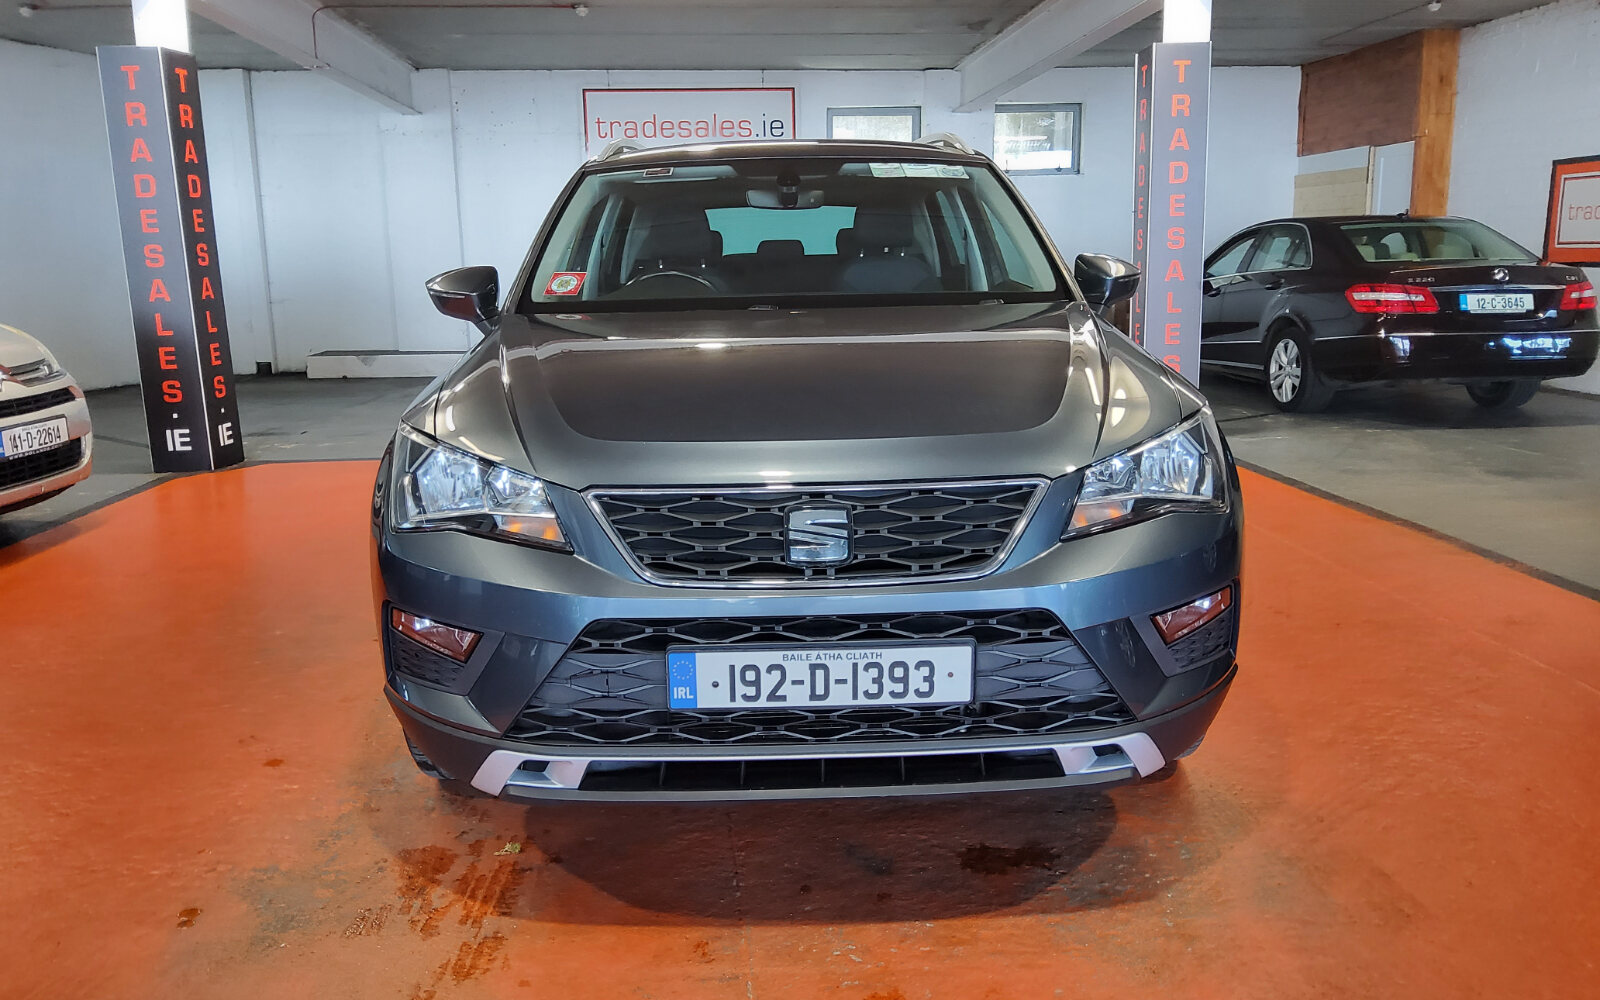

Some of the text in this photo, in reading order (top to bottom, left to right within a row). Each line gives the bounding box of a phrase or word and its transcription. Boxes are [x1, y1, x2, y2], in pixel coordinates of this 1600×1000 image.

[595, 113, 784, 139] tradesales.ie
[1476, 297, 1525, 309] 12-C-3645
[9, 425, 61, 452] 141-D-22614
[782, 653, 812, 662] BAILE
[845, 651, 883, 661] CLIATH
[728, 660, 936, 703] 192-D-1393
[673, 686, 694, 700] IRL
